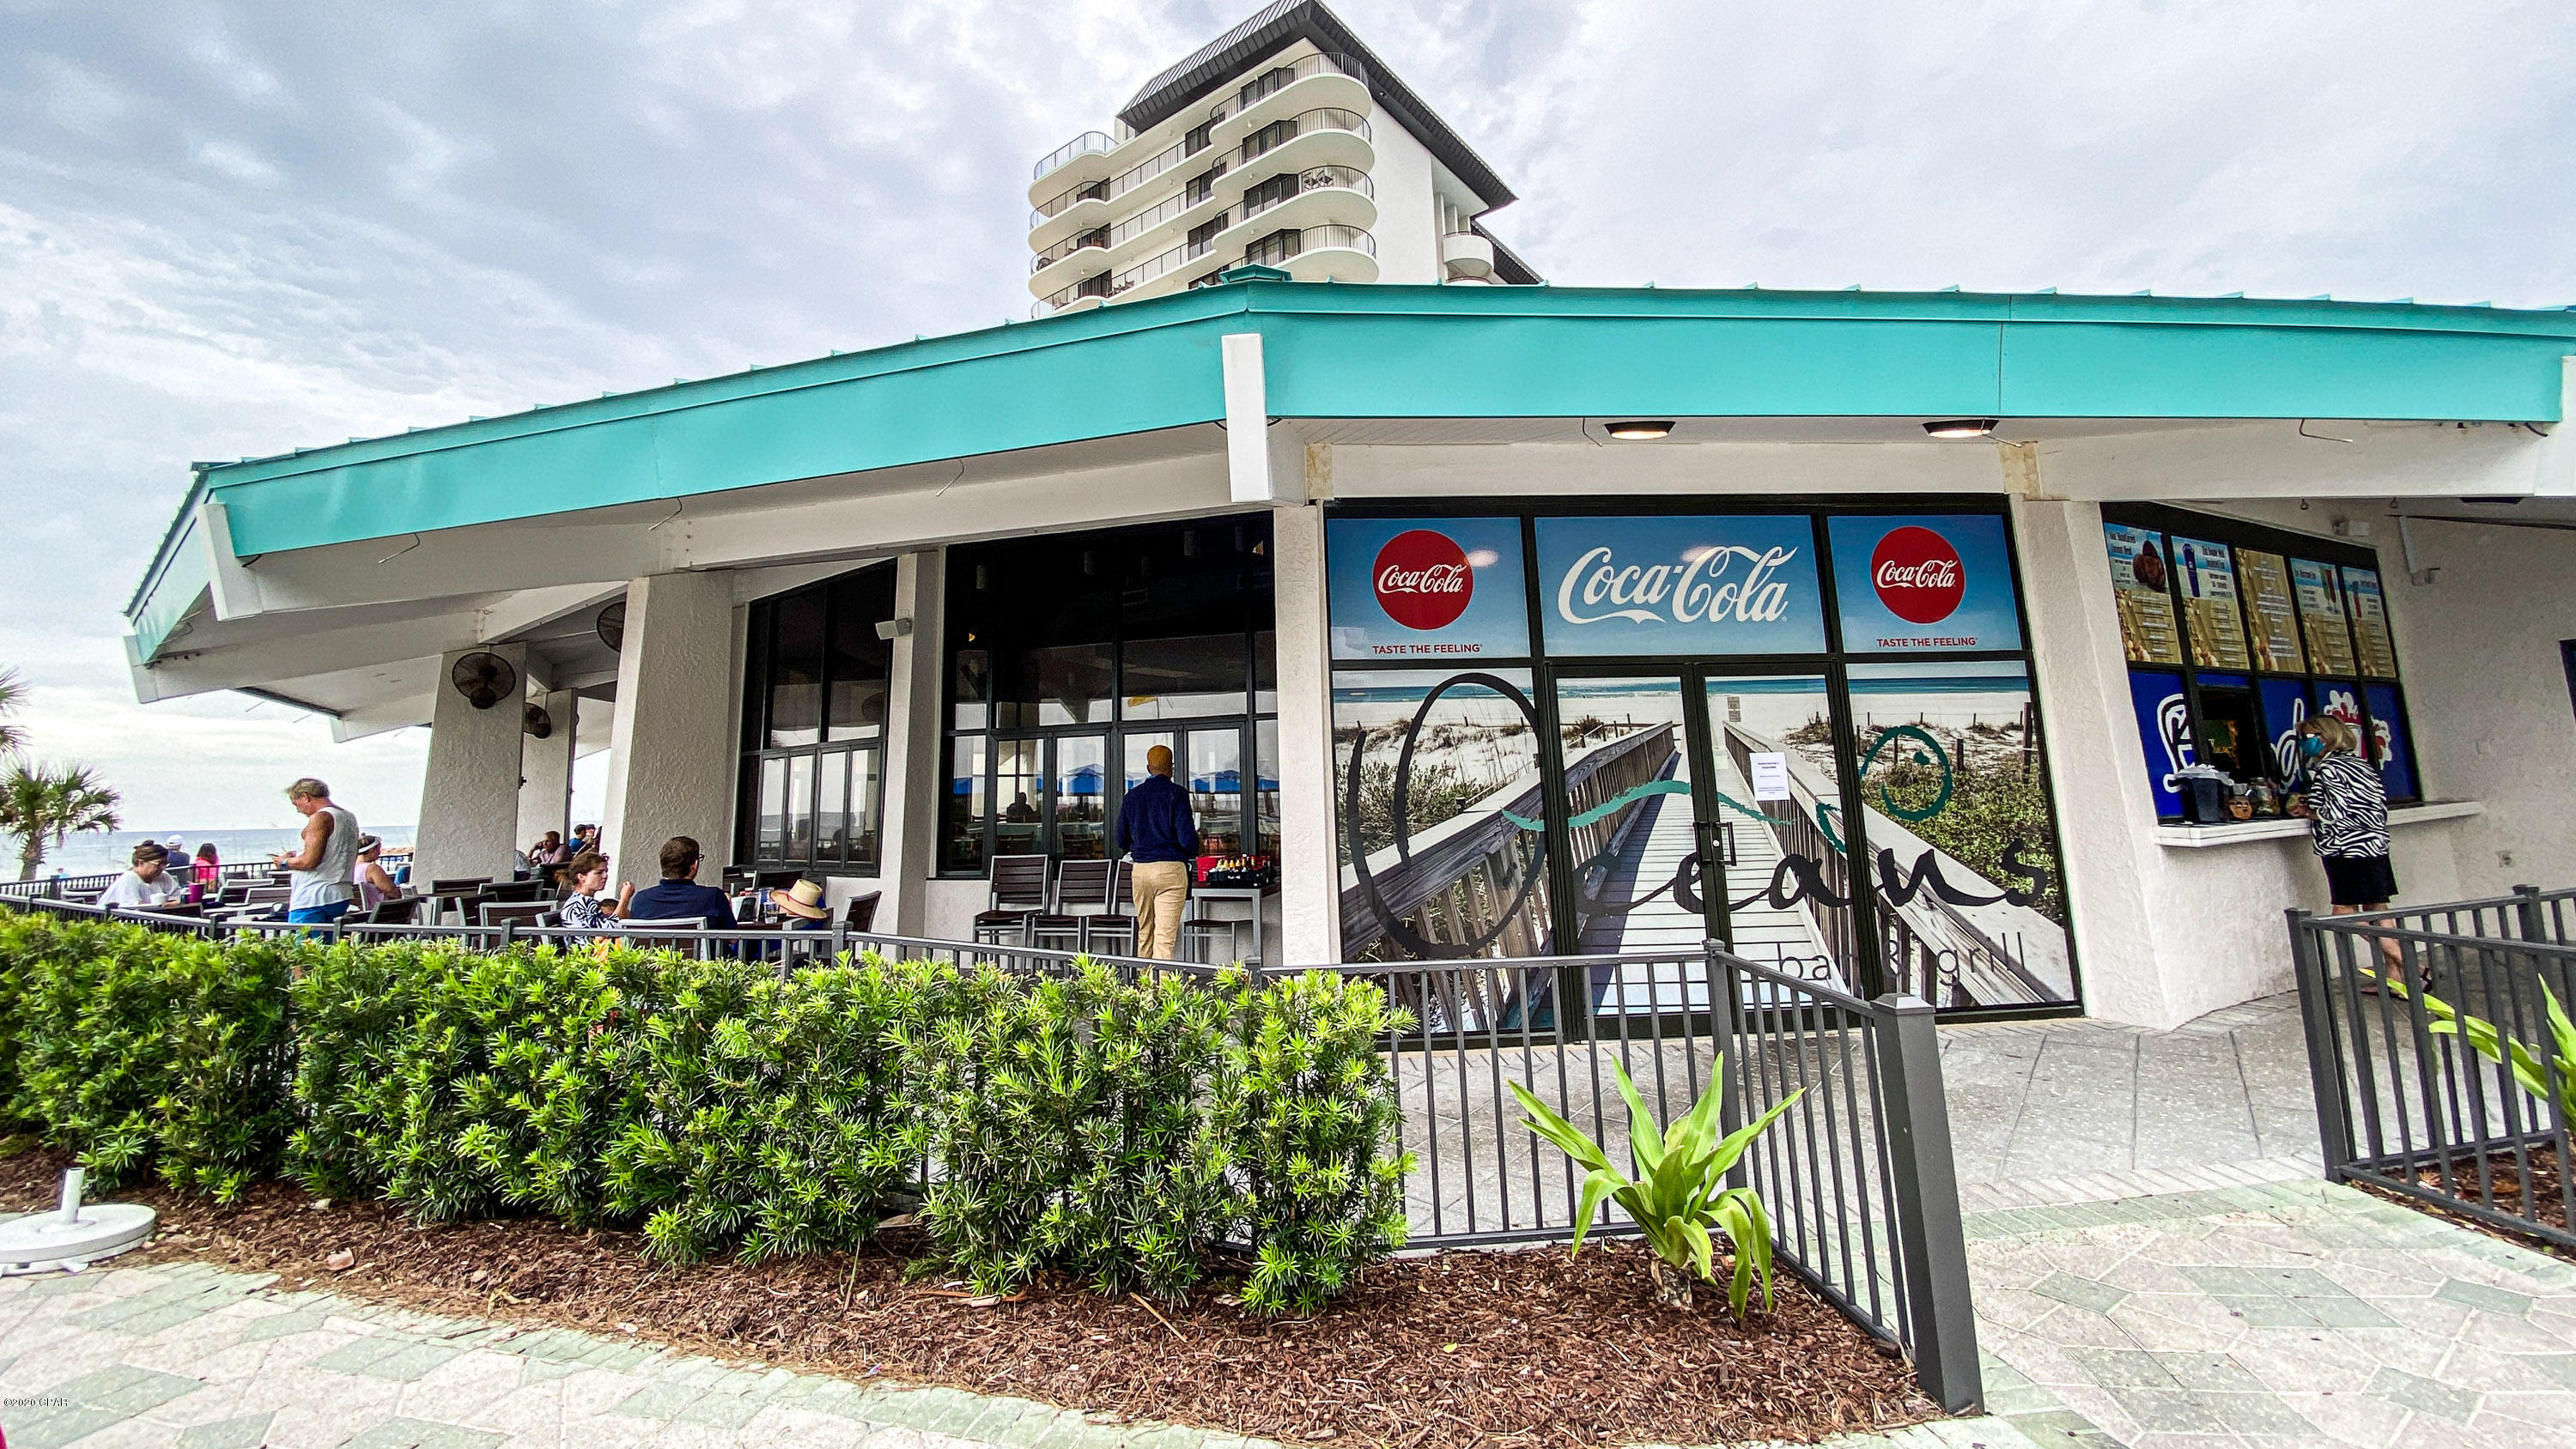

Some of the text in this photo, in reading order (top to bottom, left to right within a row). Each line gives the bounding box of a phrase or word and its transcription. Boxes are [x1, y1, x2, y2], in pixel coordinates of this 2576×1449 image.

[1378, 564, 1467, 594] Coca-Cola
[1558, 545, 1798, 625] Coca-Cola
[1876, 560, 1958, 589] Coca-Cola
[1372, 646, 1406, 654] TASTE
[1409, 645, 1431, 653] THE
[1876, 638, 1908, 647] TASTE
[1911, 638, 1931, 646] THE
[1936, 931, 2025, 985] grill
